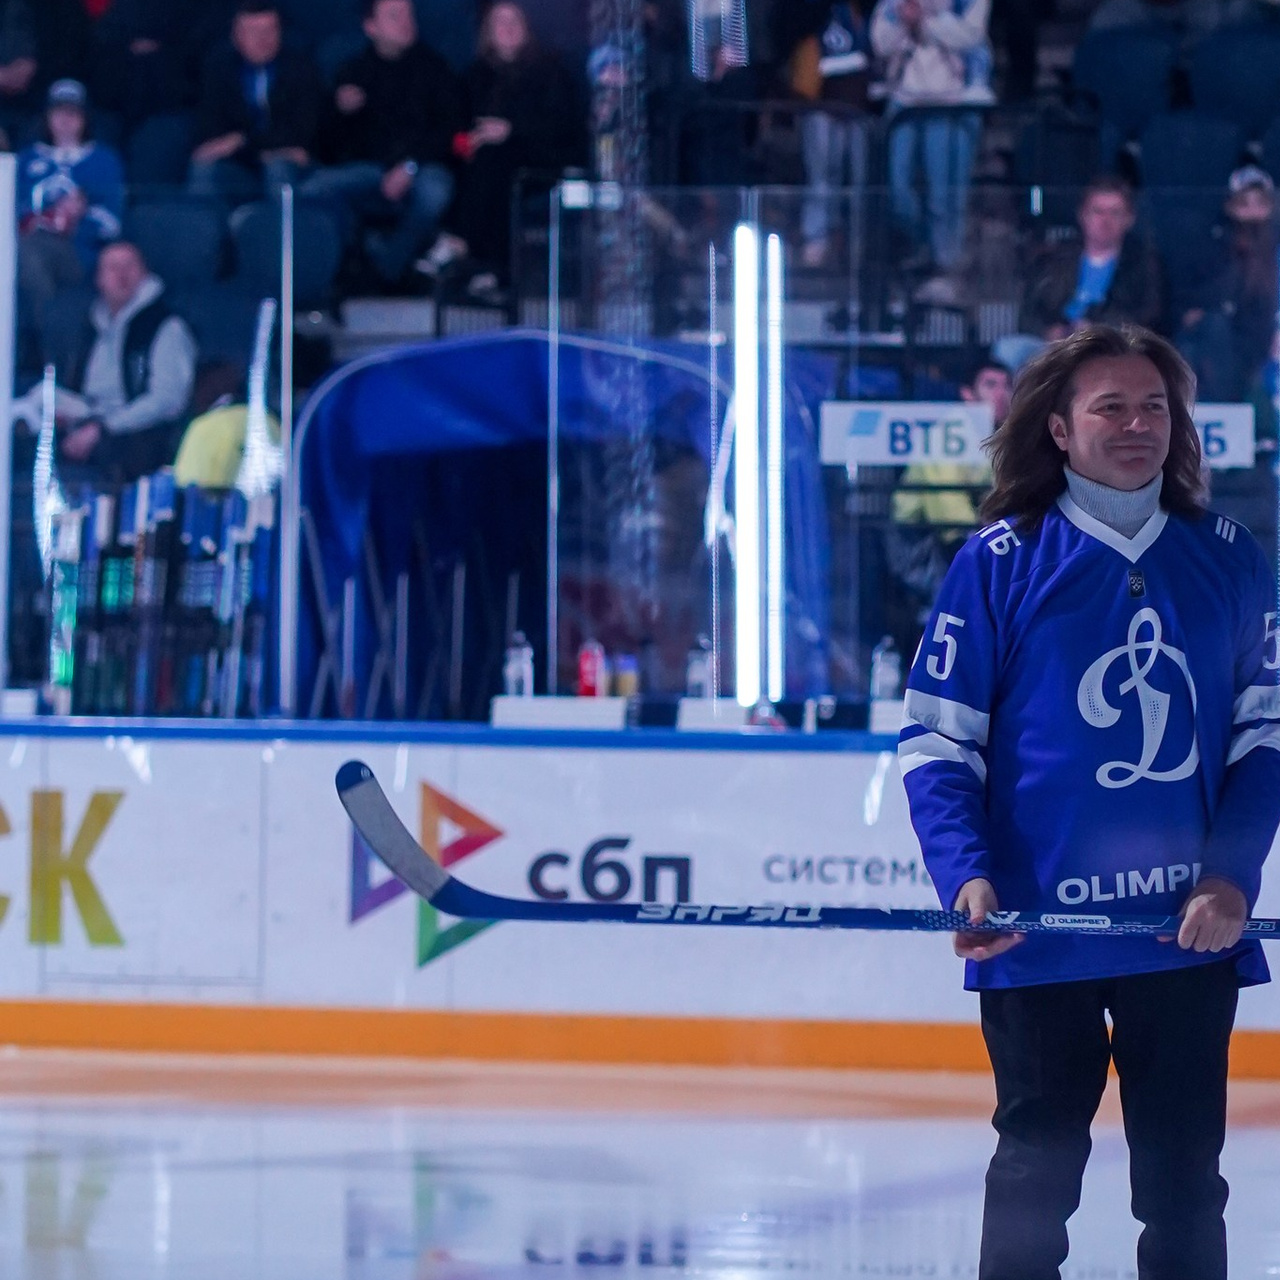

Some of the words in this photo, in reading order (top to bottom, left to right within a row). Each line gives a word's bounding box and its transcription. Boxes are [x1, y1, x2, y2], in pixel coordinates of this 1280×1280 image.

[888, 420, 966, 456] ВТБ
[975, 518, 1021, 556] ТБ
[911, 612, 966, 681] 5
[529, 837, 691, 903] сбп
[1058, 917, 1107, 926] OLIMPBET
